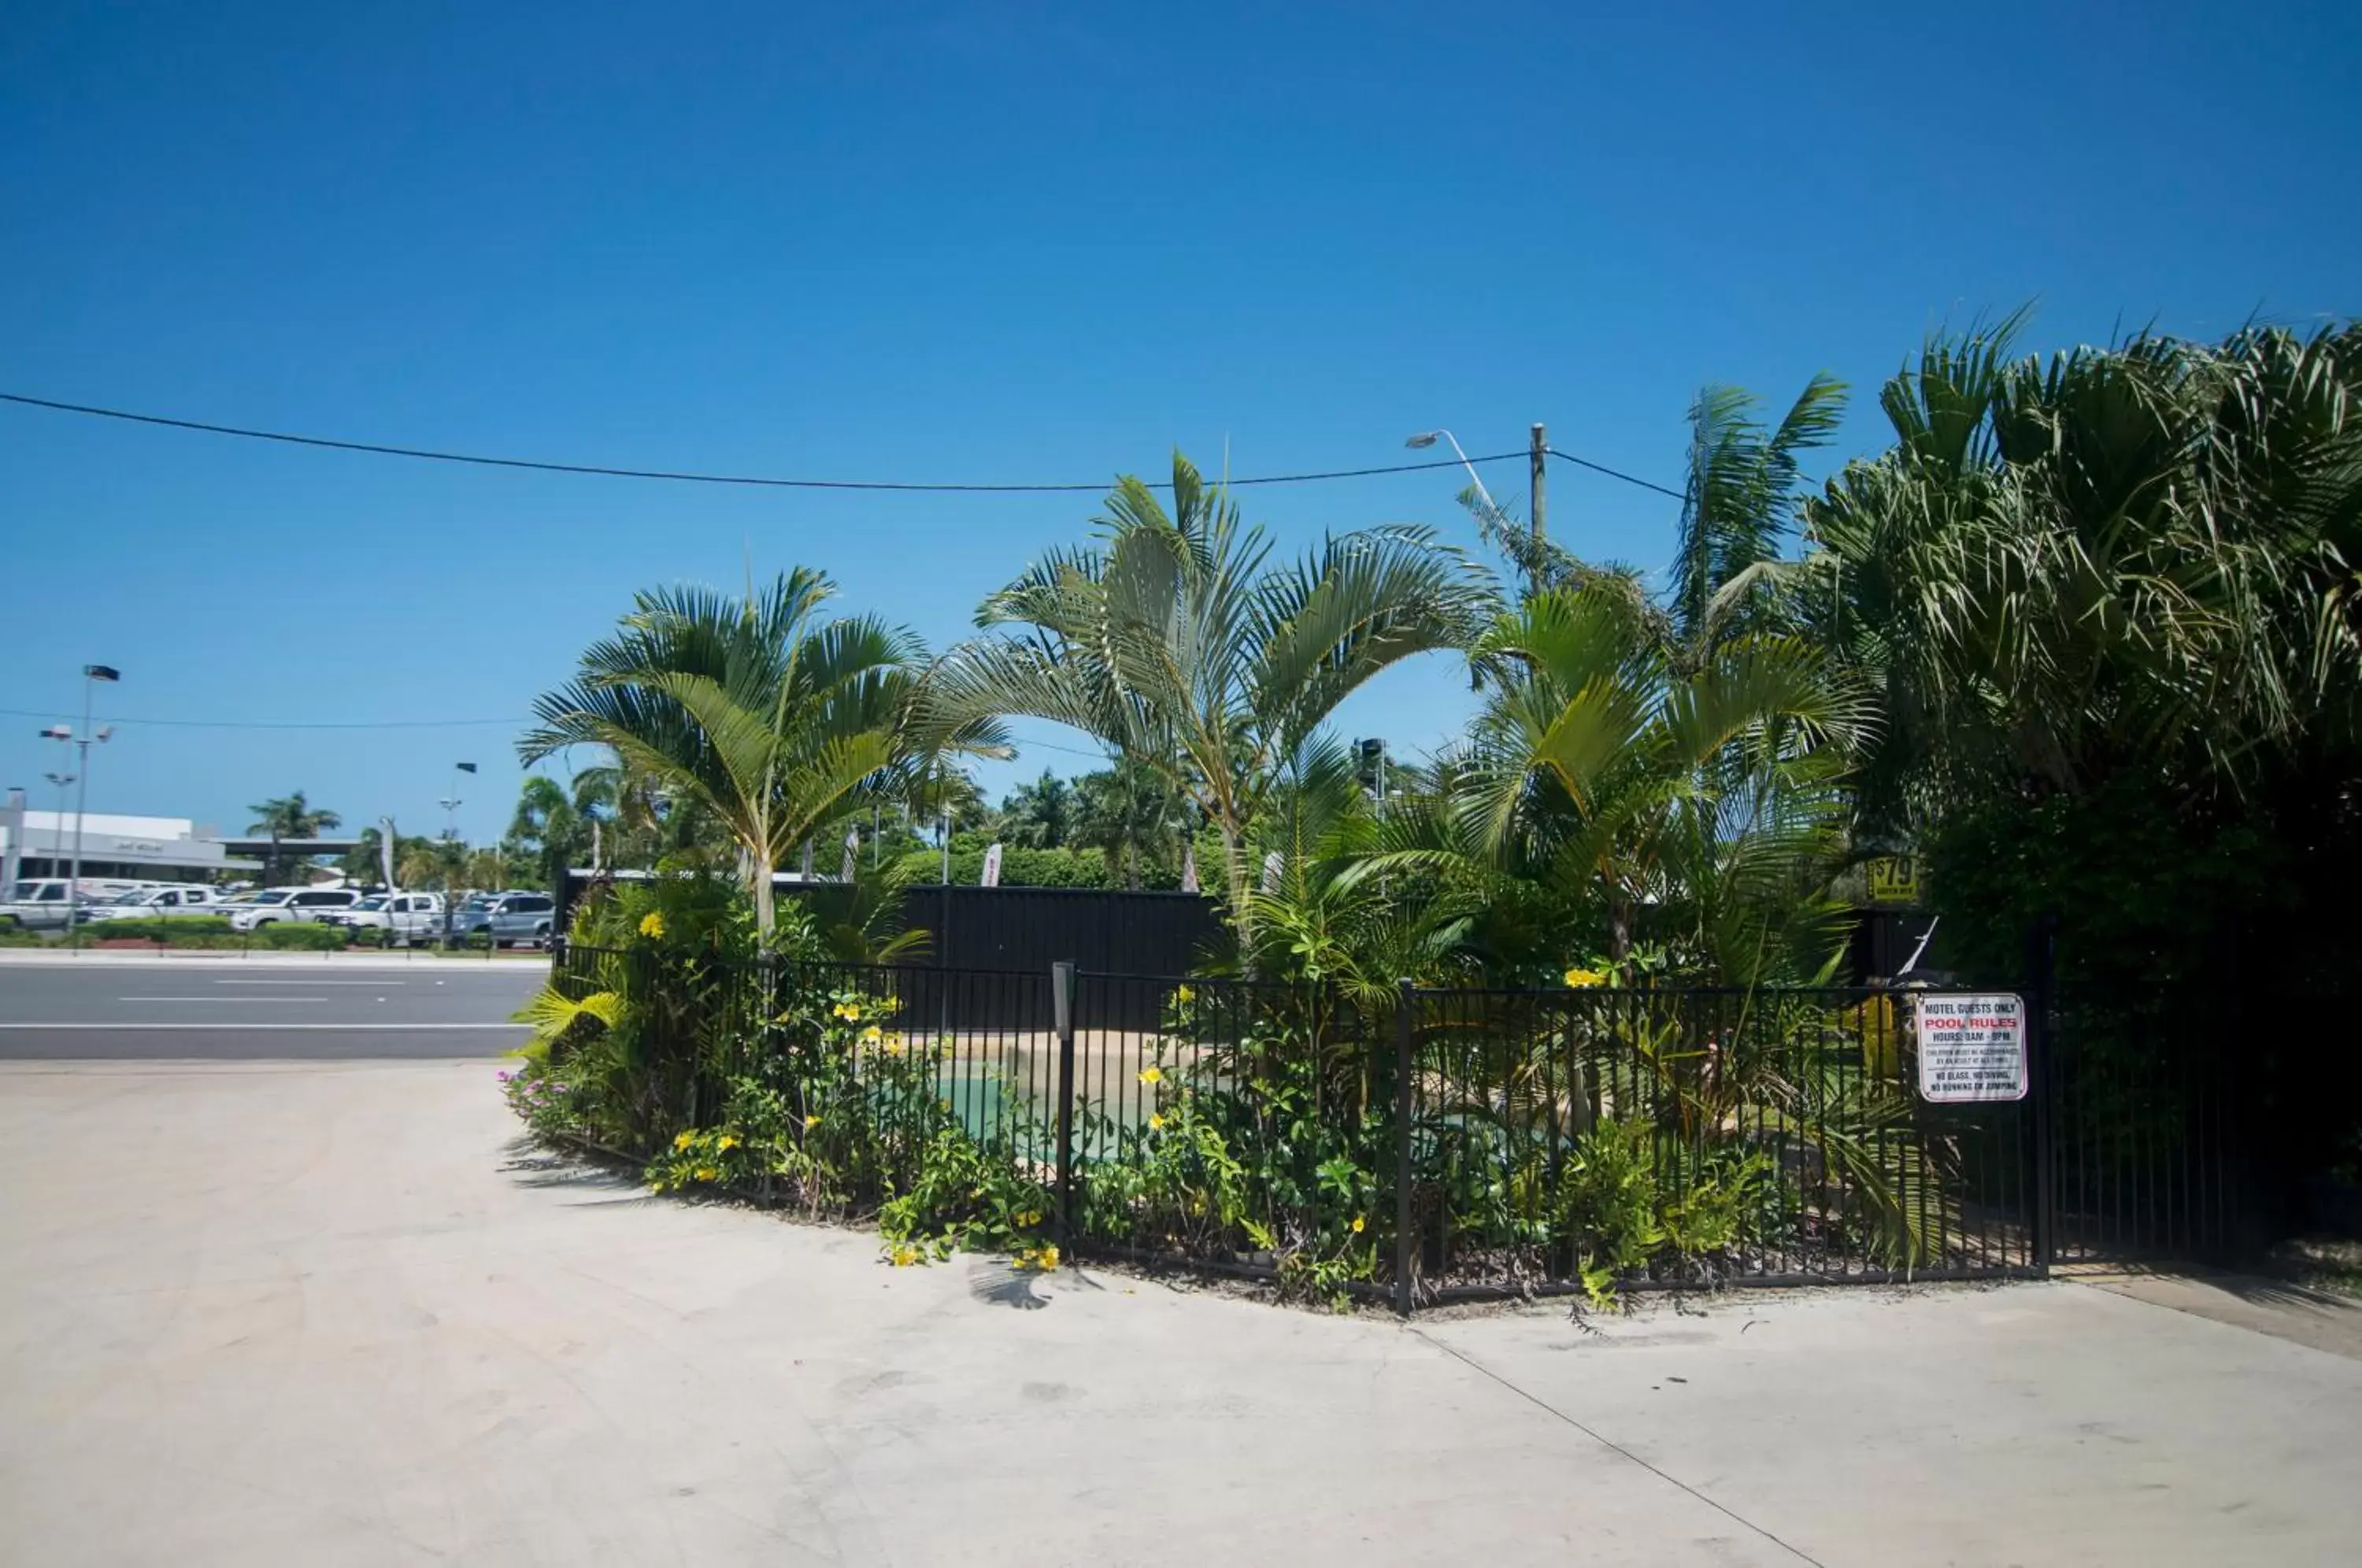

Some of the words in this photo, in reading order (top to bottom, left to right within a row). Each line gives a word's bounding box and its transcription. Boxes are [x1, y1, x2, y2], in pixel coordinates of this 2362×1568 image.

[1875, 856, 1912, 885] $79
[1925, 1004, 1956, 1014] MOTEL
[1957, 1004, 1990, 1014] GUESTS
[1994, 1004, 2016, 1013] ONLY
[1925, 1018, 1965, 1028] POOL
[1969, 1018, 2017, 1027] RULES
